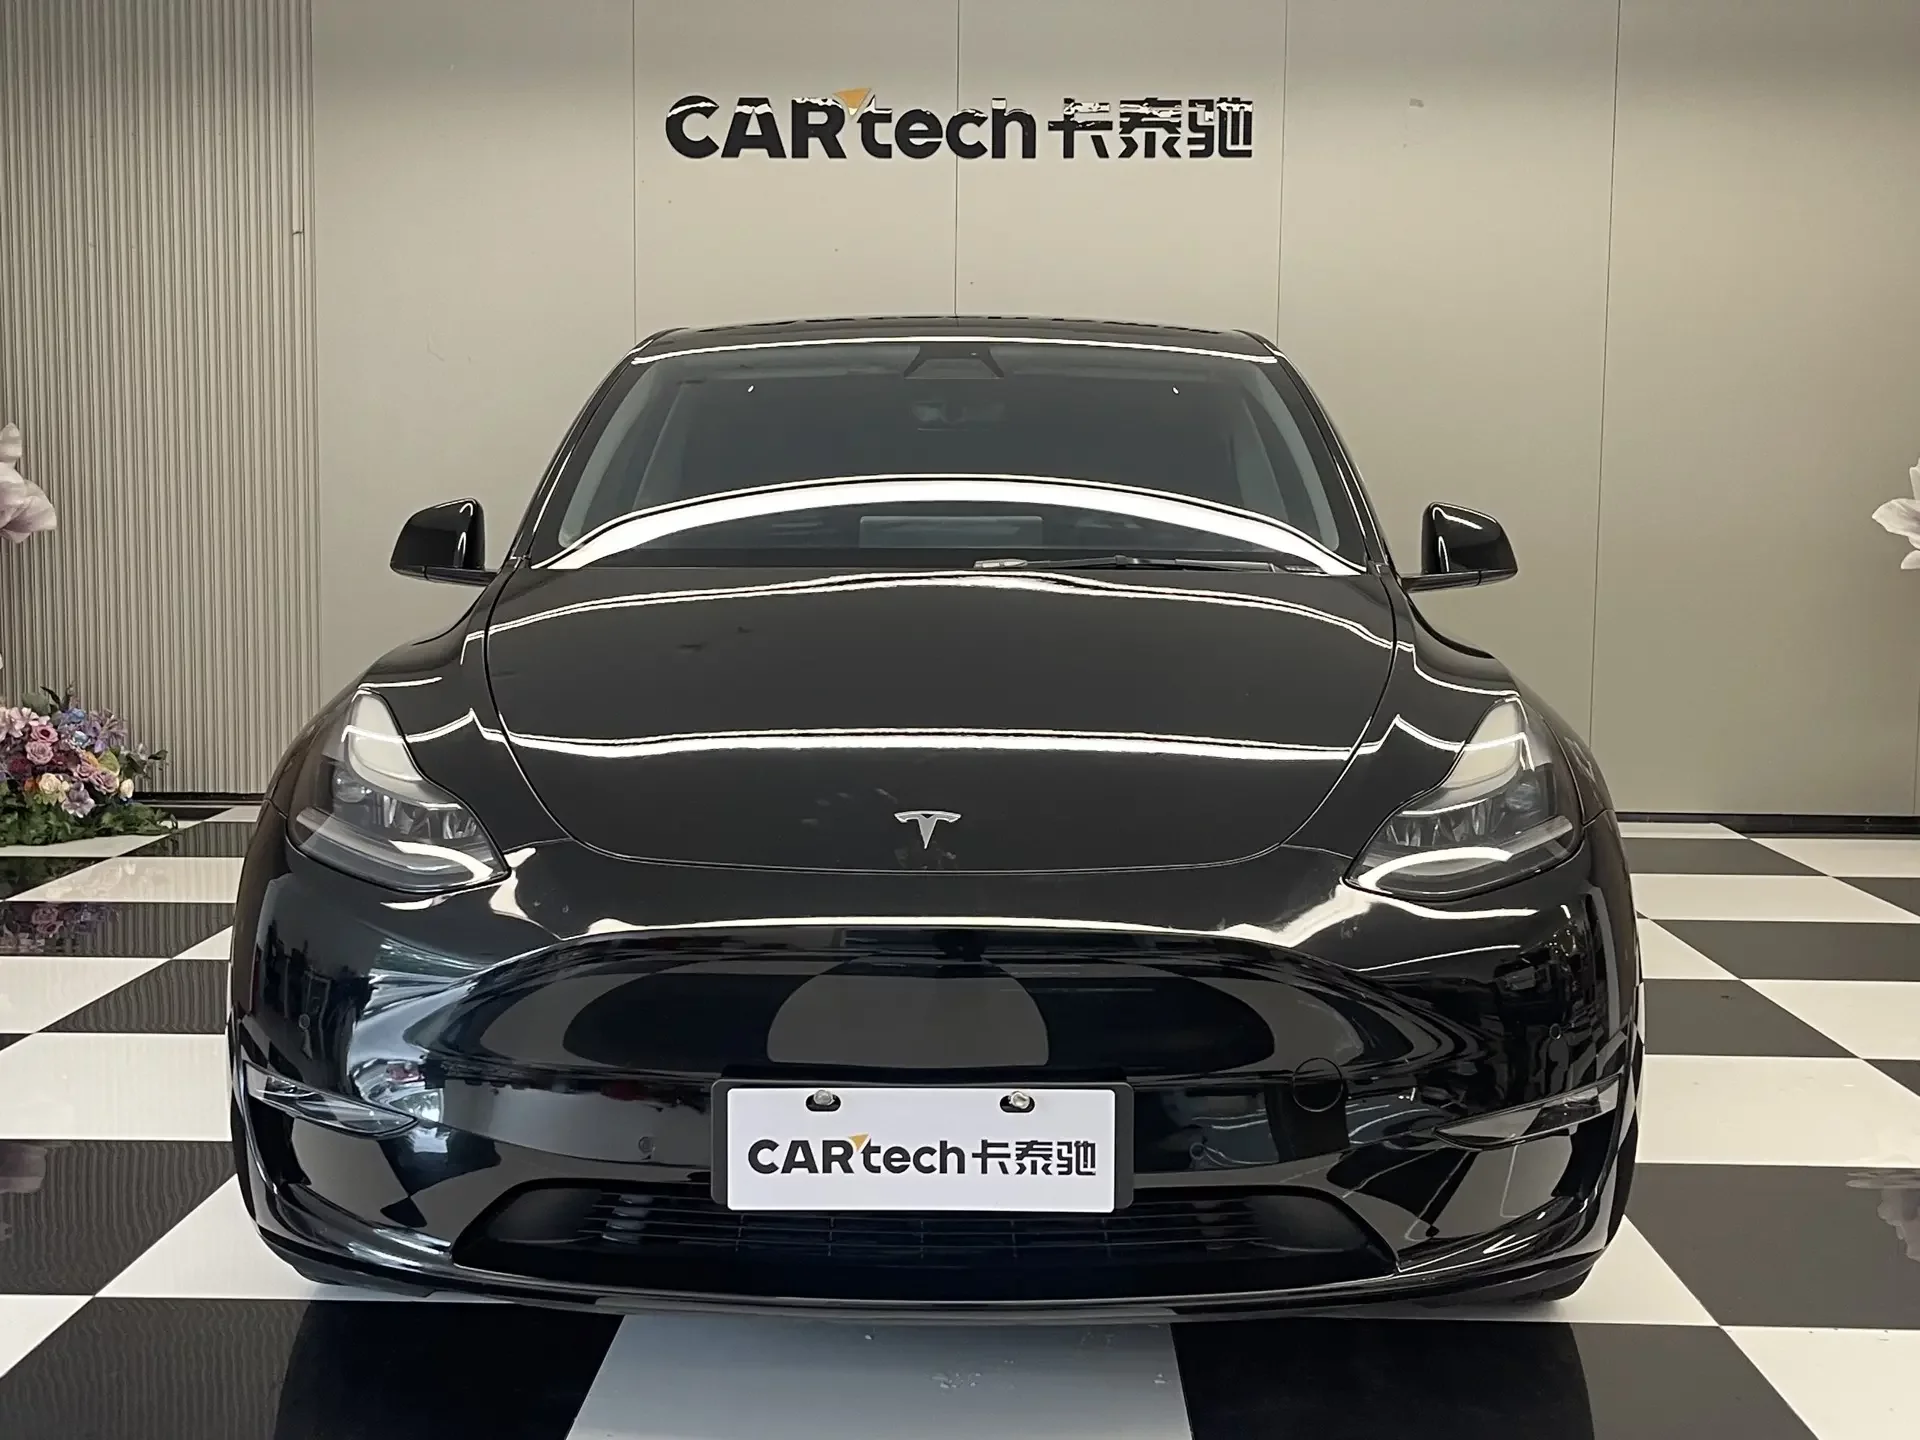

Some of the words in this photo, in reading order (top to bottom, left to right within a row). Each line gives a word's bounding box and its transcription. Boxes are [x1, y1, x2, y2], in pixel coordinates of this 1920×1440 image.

[665, 92, 1037, 160] CARtech
[1047, 96, 1253, 159] 卡泰驰
[747, 1136, 966, 1176] CARtech
[971, 1138, 1097, 1177] 卡泰驰
